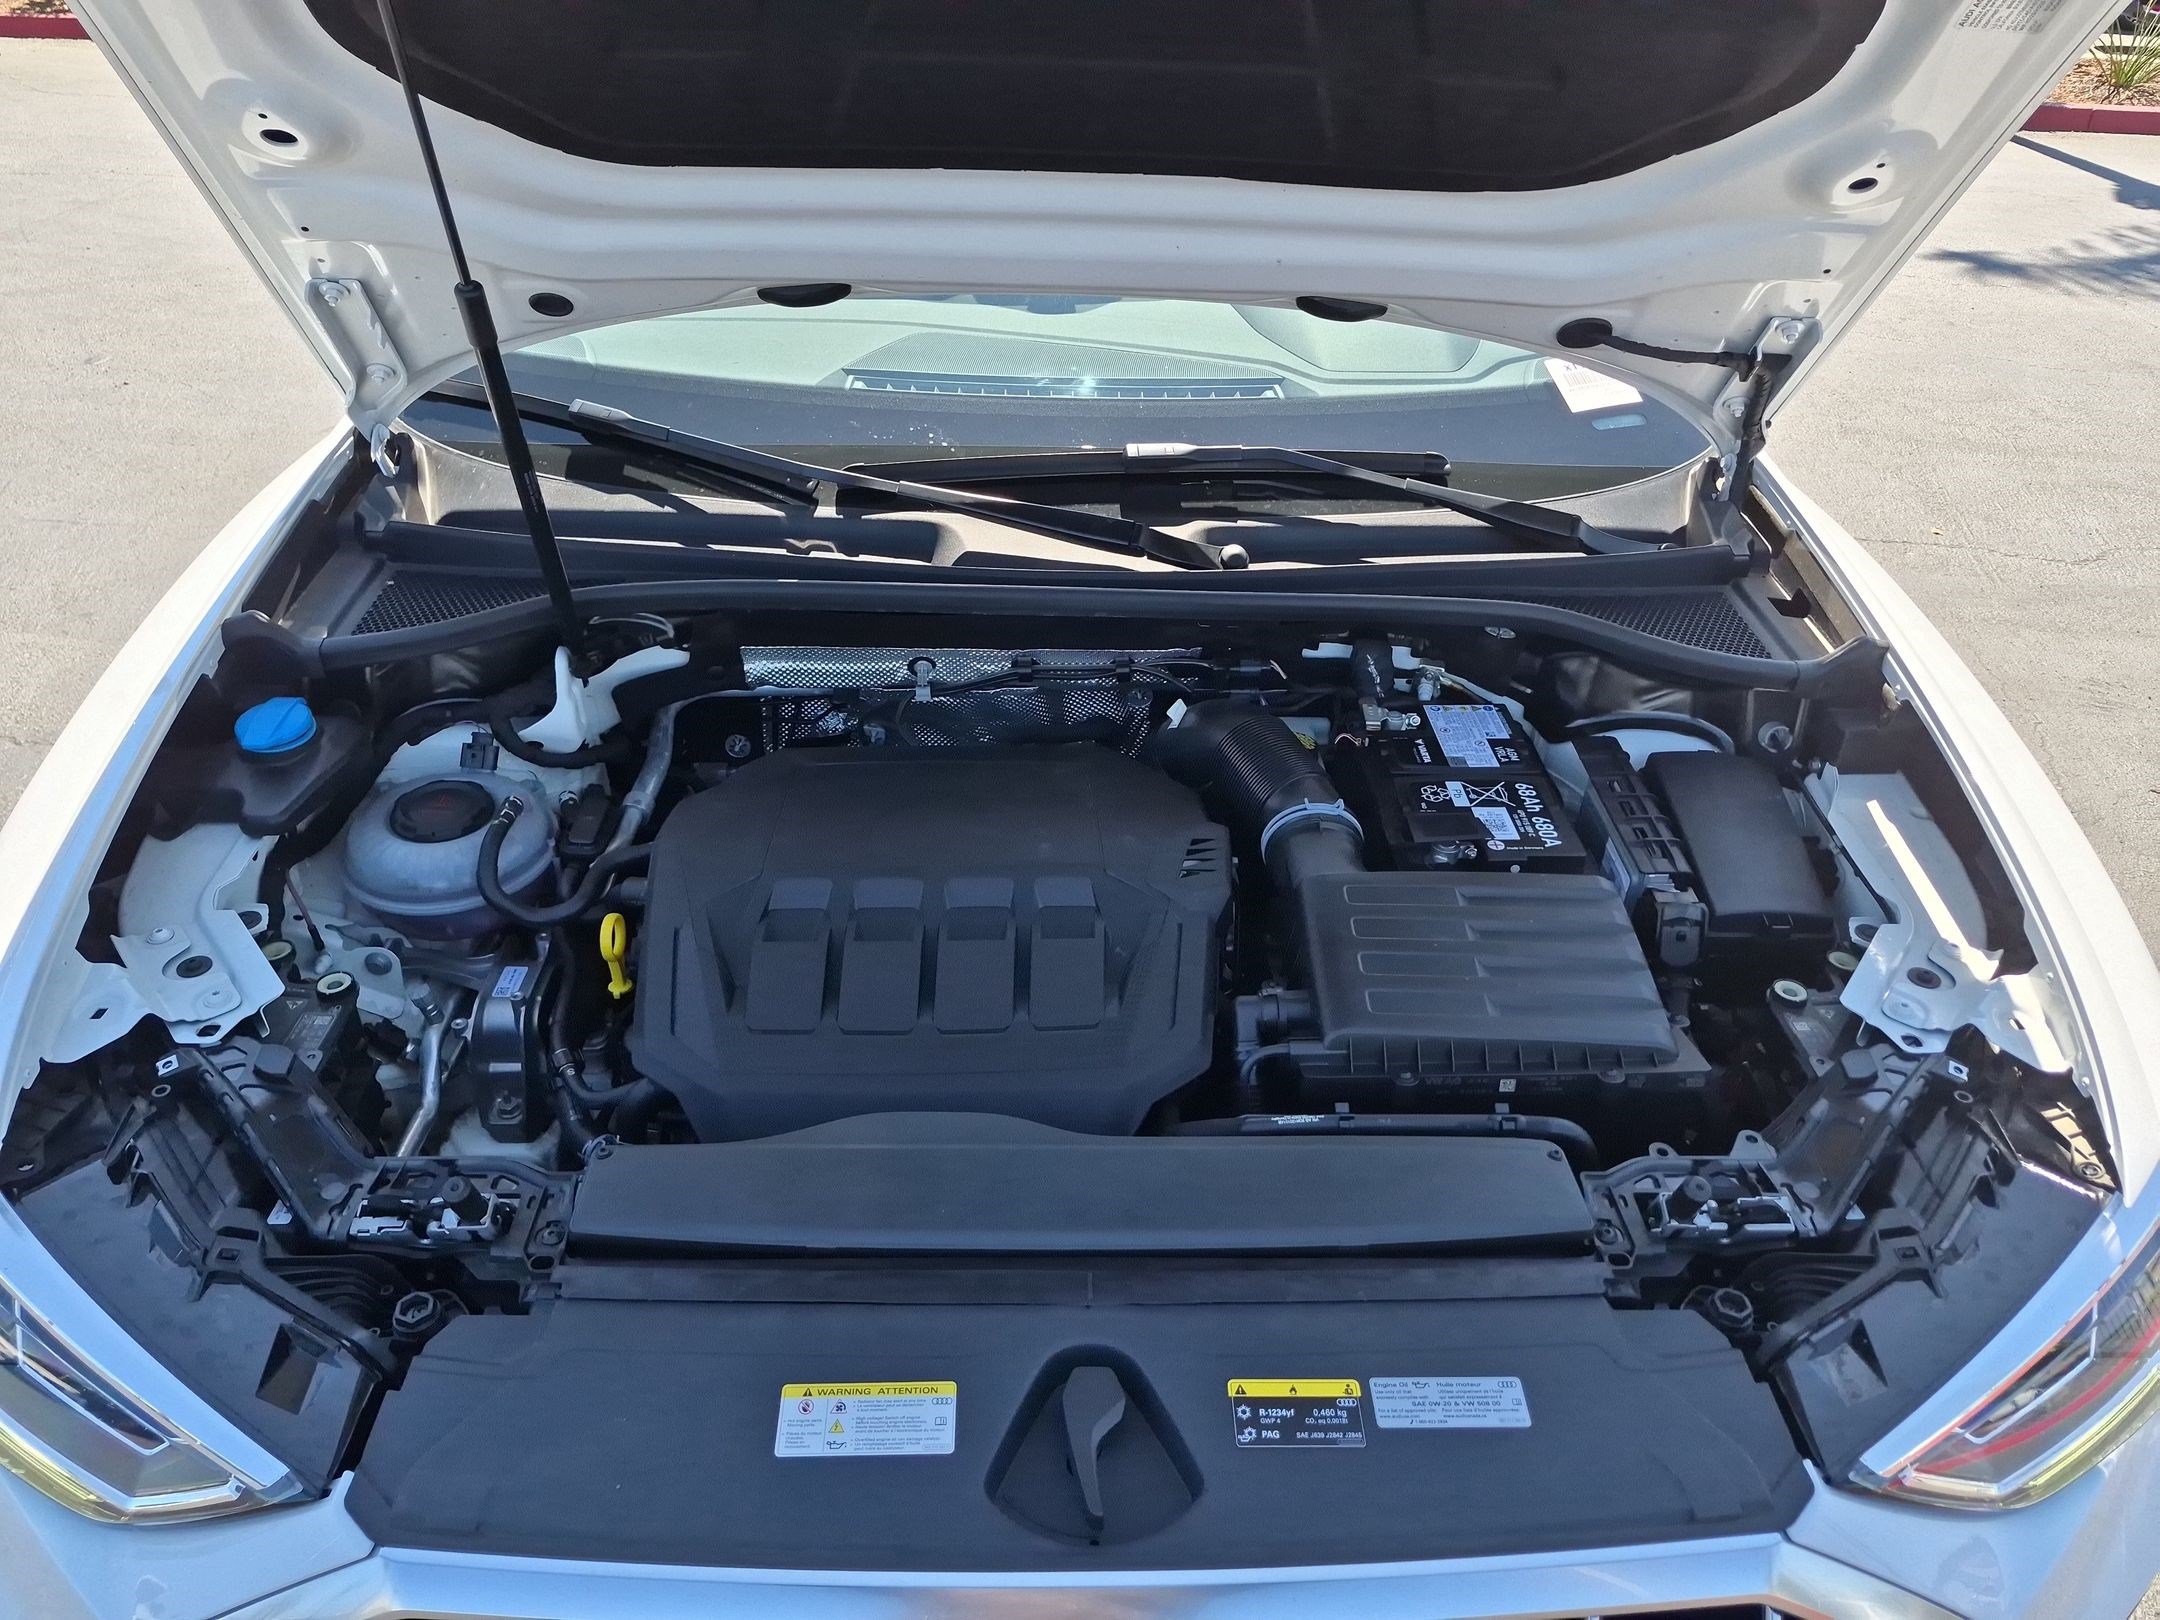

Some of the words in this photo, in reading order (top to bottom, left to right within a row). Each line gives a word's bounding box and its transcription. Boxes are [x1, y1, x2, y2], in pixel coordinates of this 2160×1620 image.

[1958, 8, 1976, 27] AUDI
[1418, 744, 1432, 763] VARTA
[1504, 747, 1520, 761] AGM
[1452, 789, 1464, 799] Pb
[1515, 783, 1544, 812] 68Ah
[1531, 816, 1562, 847] 680A
[817, 1388, 871, 1396] WARNING
[878, 1387, 938, 1395] ATTENTION
[1259, 1408, 1294, 1418] R-1234yf
[1336, 1409, 1348, 1418] kg
[1261, 1430, 1280, 1439] PAG
